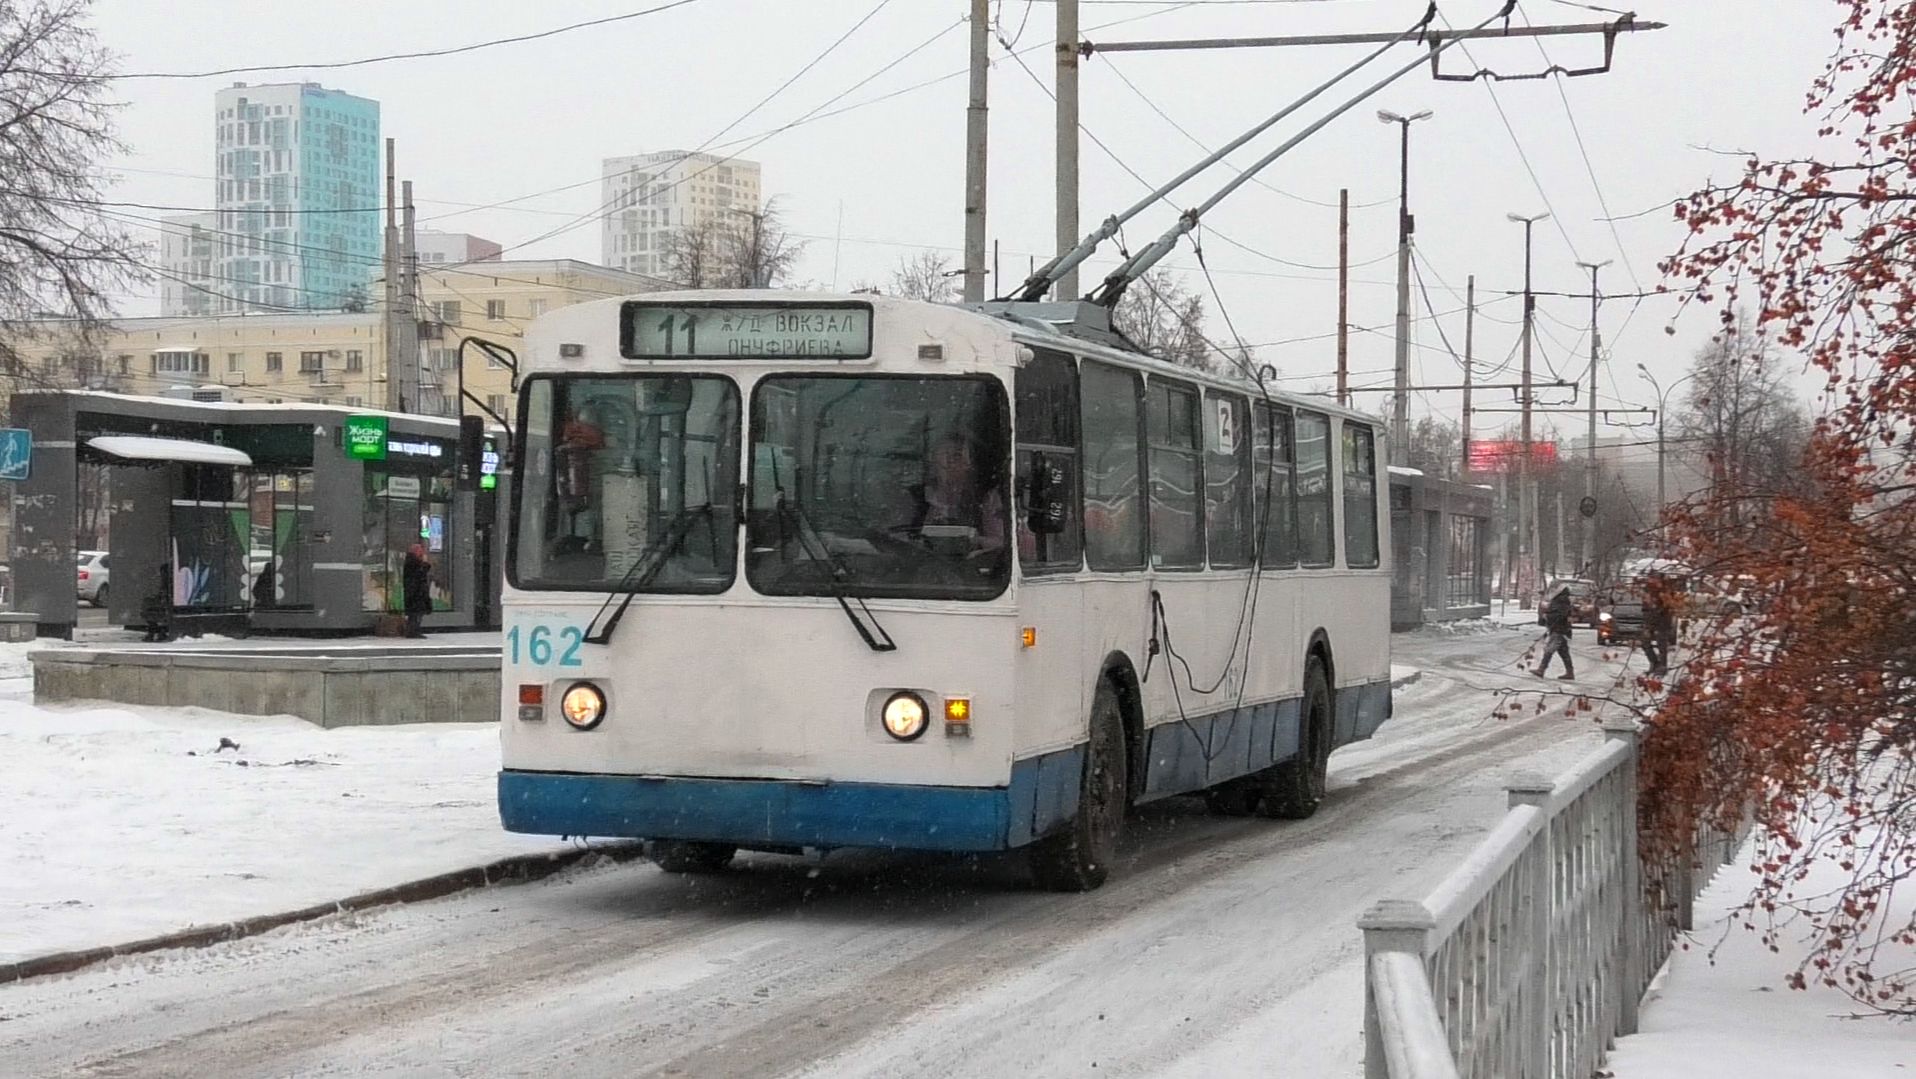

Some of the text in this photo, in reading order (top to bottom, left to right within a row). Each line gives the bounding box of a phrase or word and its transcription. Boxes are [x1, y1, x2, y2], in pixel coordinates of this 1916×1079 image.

[720, 312, 853, 333] Ж/Д ВОКЗАЛ
[657, 314, 698, 355] 11
[728, 338, 844, 356] ОНУФРИЕВА
[348, 424, 383, 438] Жизнь
[1220, 407, 1230, 438] 2
[1050, 502, 1063, 521] 162
[506, 624, 583, 667] 162
